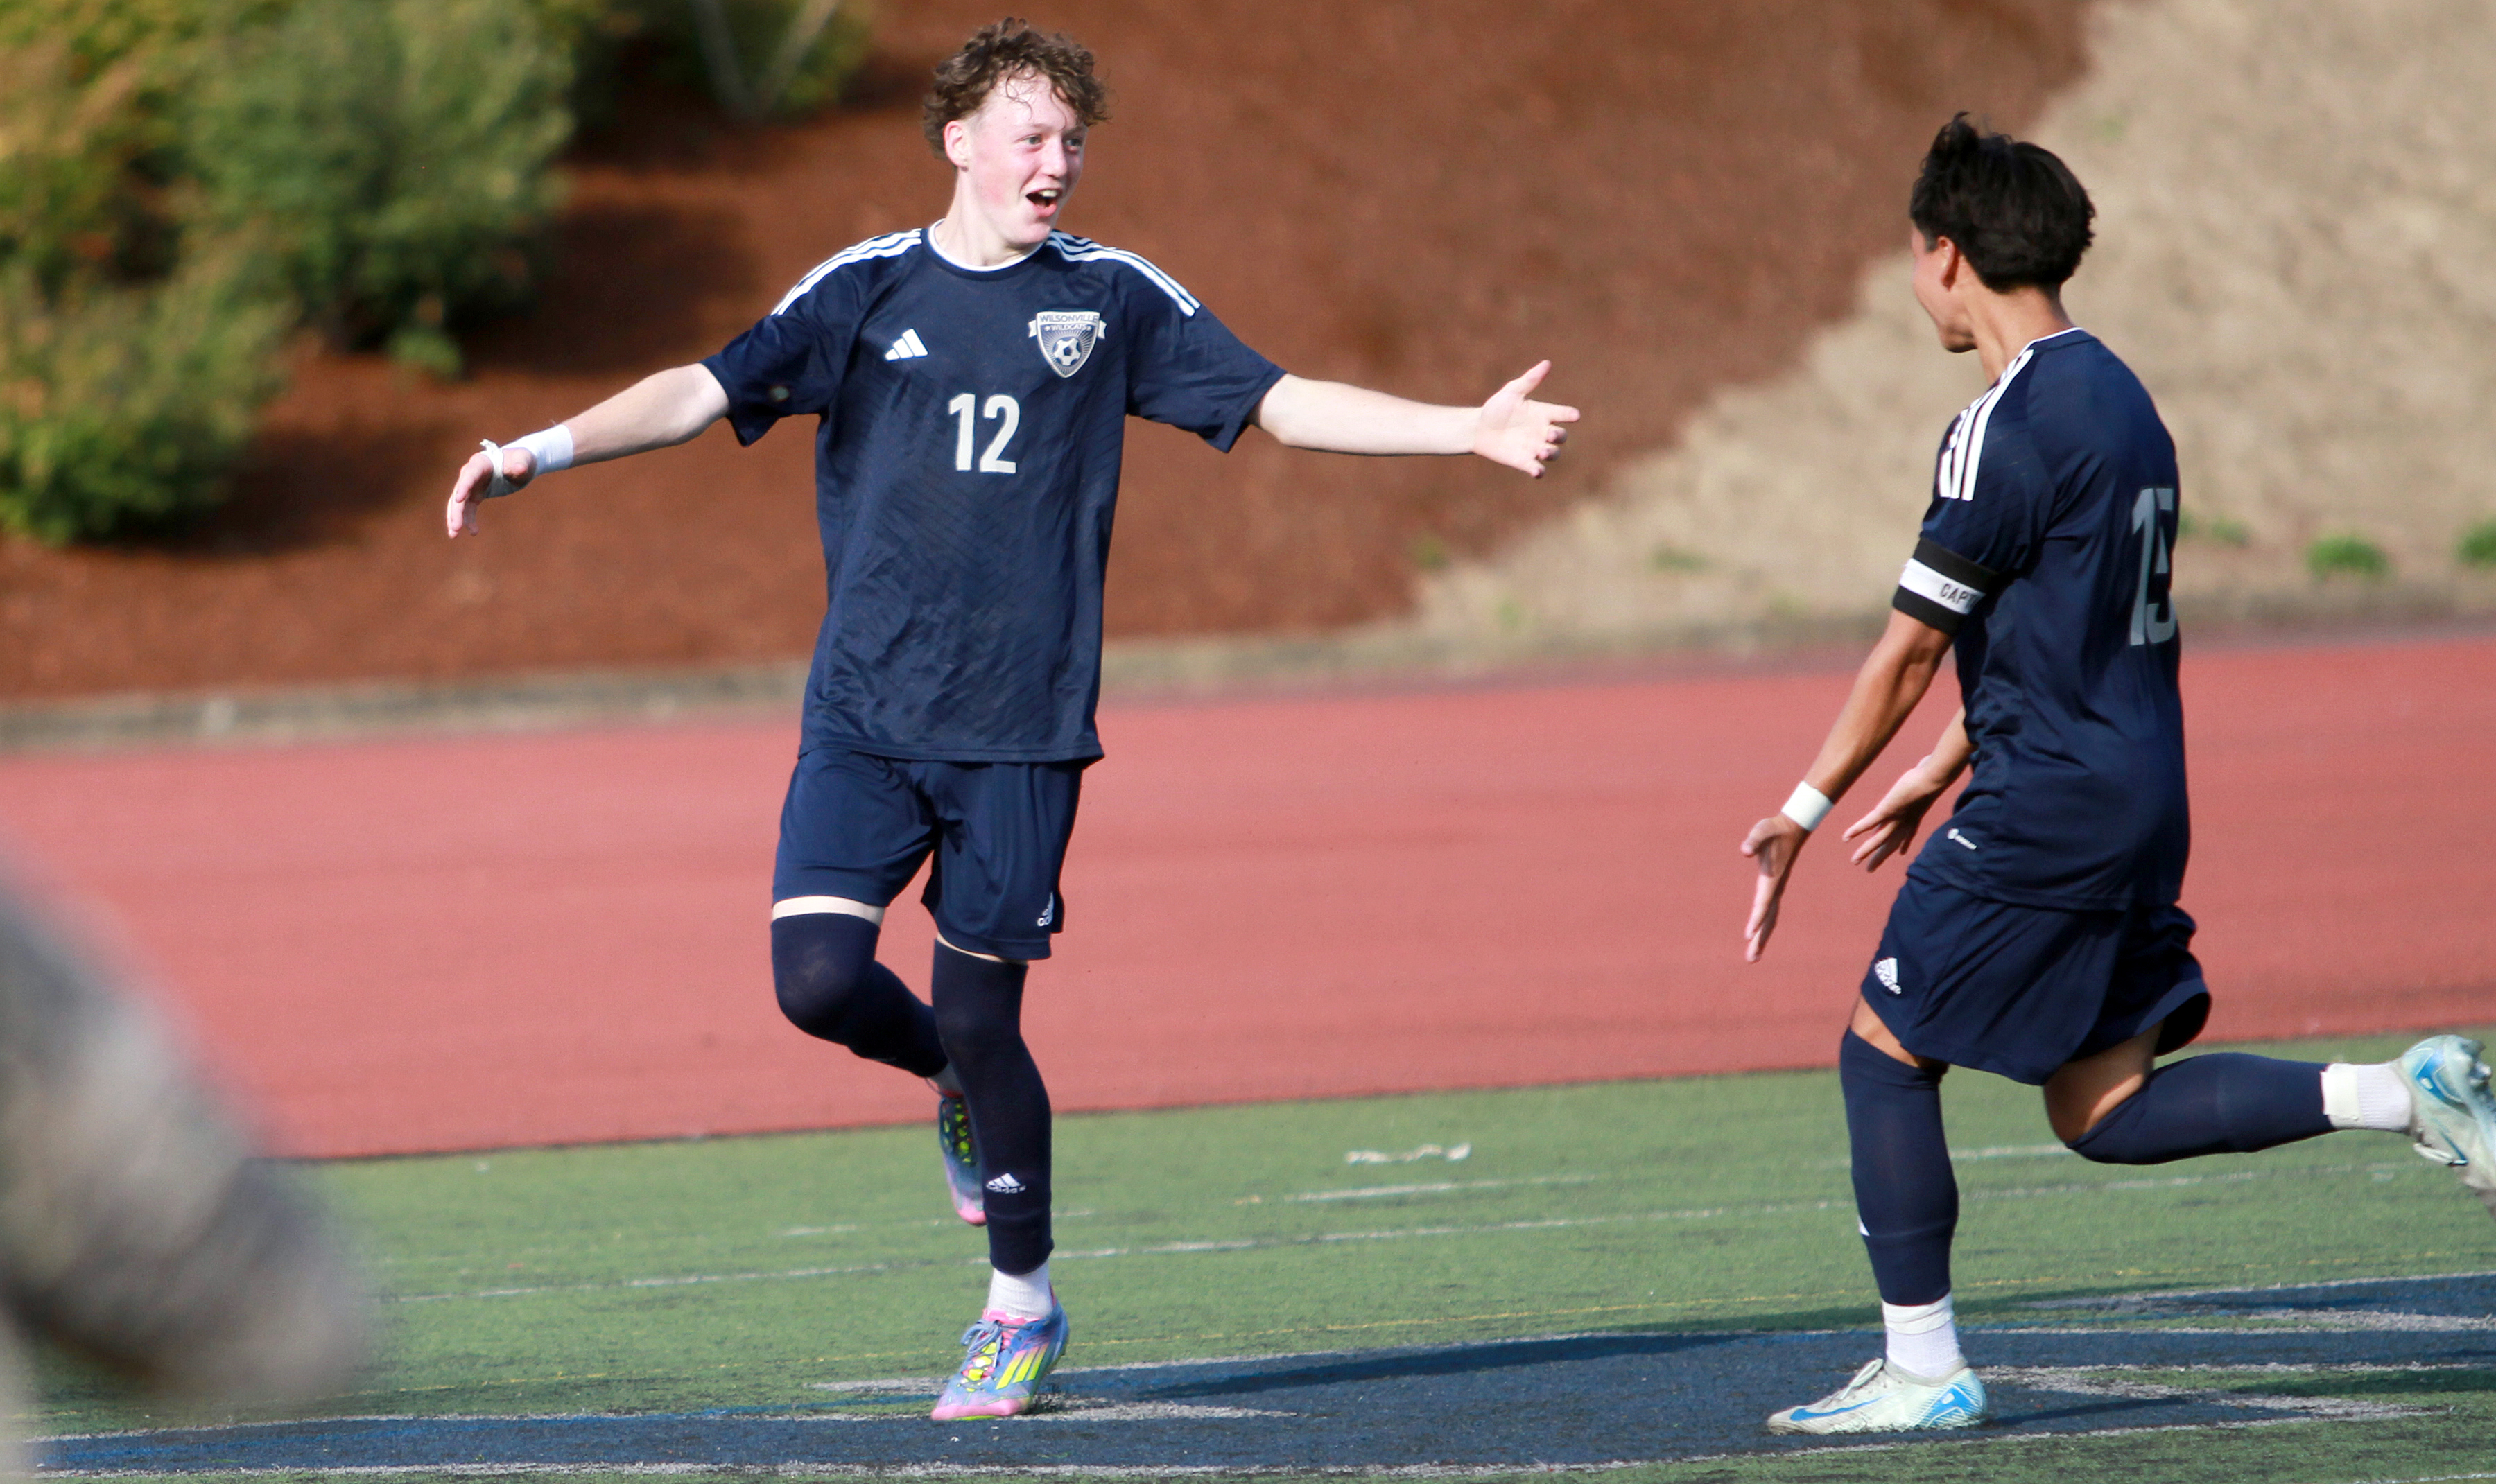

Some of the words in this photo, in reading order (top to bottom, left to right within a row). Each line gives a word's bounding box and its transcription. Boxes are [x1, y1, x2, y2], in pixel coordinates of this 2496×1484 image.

[1039, 315, 1099, 323] WILSONVILLE
[948, 392, 1020, 473] 12
[2130, 487, 2177, 646] 15
